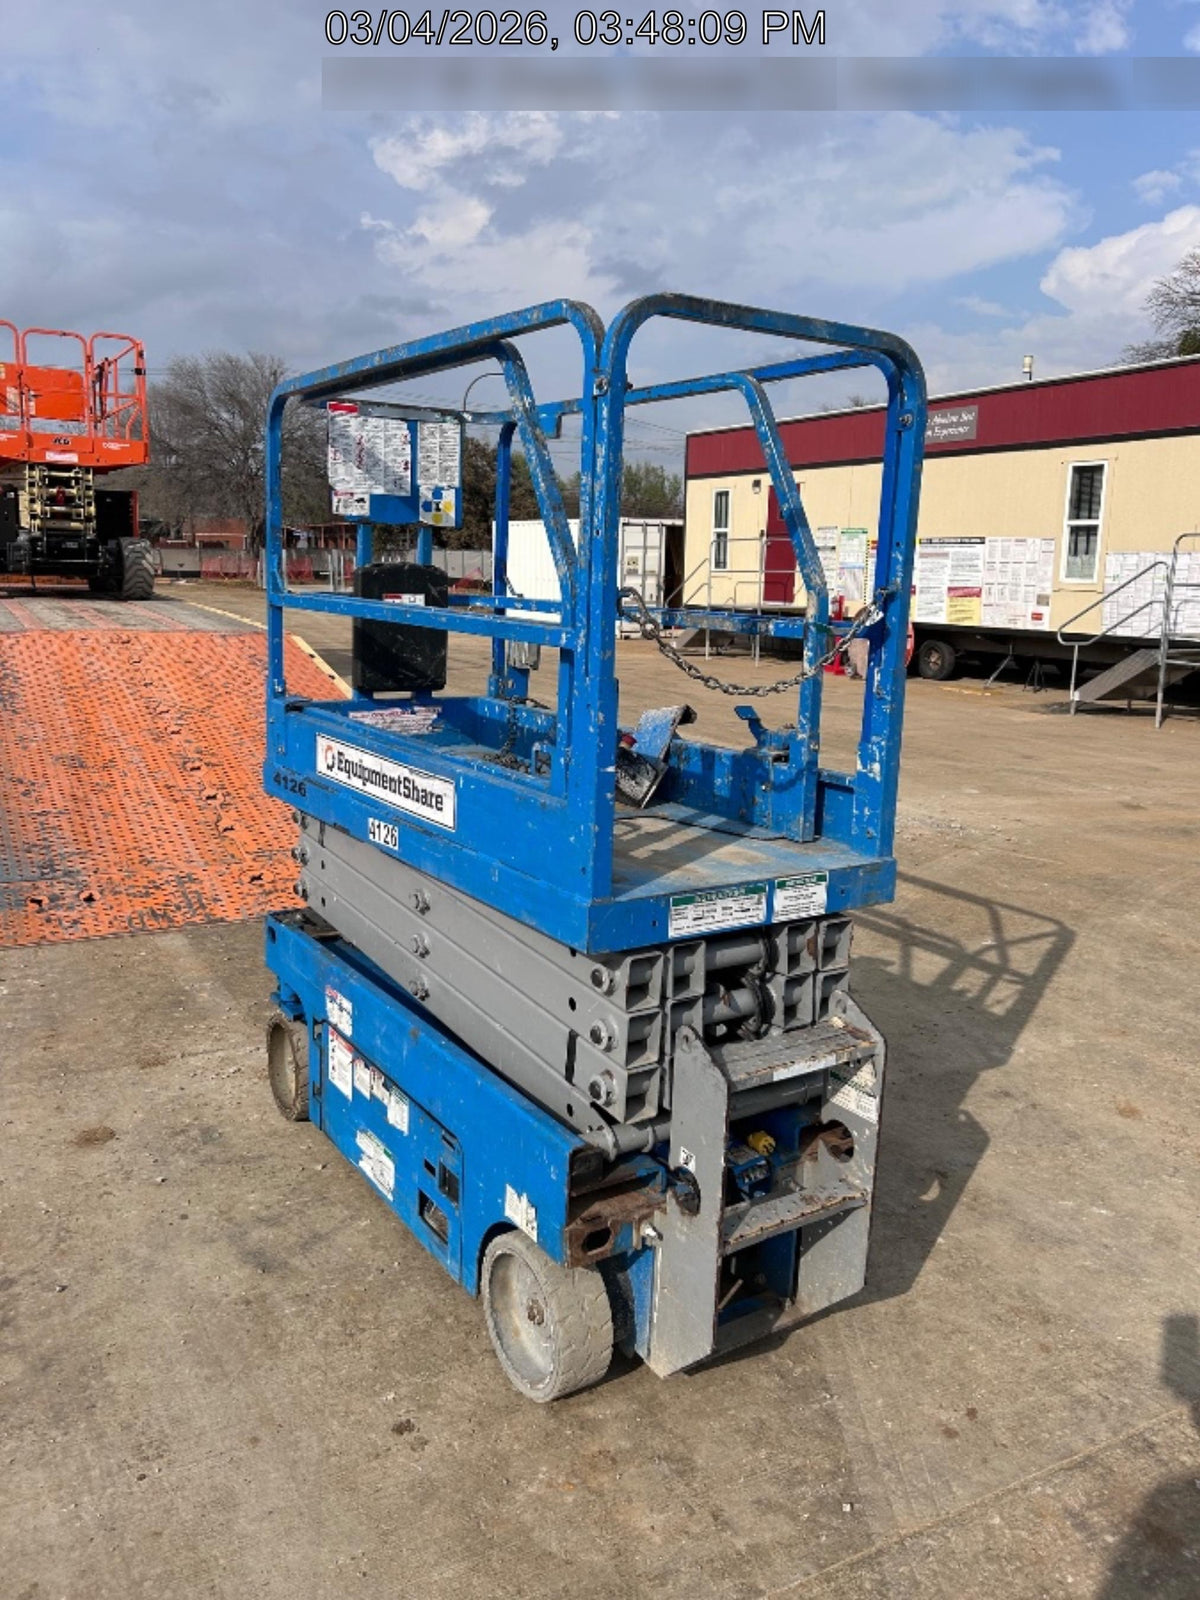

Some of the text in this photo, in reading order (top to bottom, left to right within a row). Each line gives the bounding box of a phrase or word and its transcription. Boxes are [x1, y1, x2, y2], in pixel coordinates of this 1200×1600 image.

[273, 771, 307, 798] 4126
[337, 750, 444, 812] EquipmentShare
[369, 820, 398, 847] 4126
